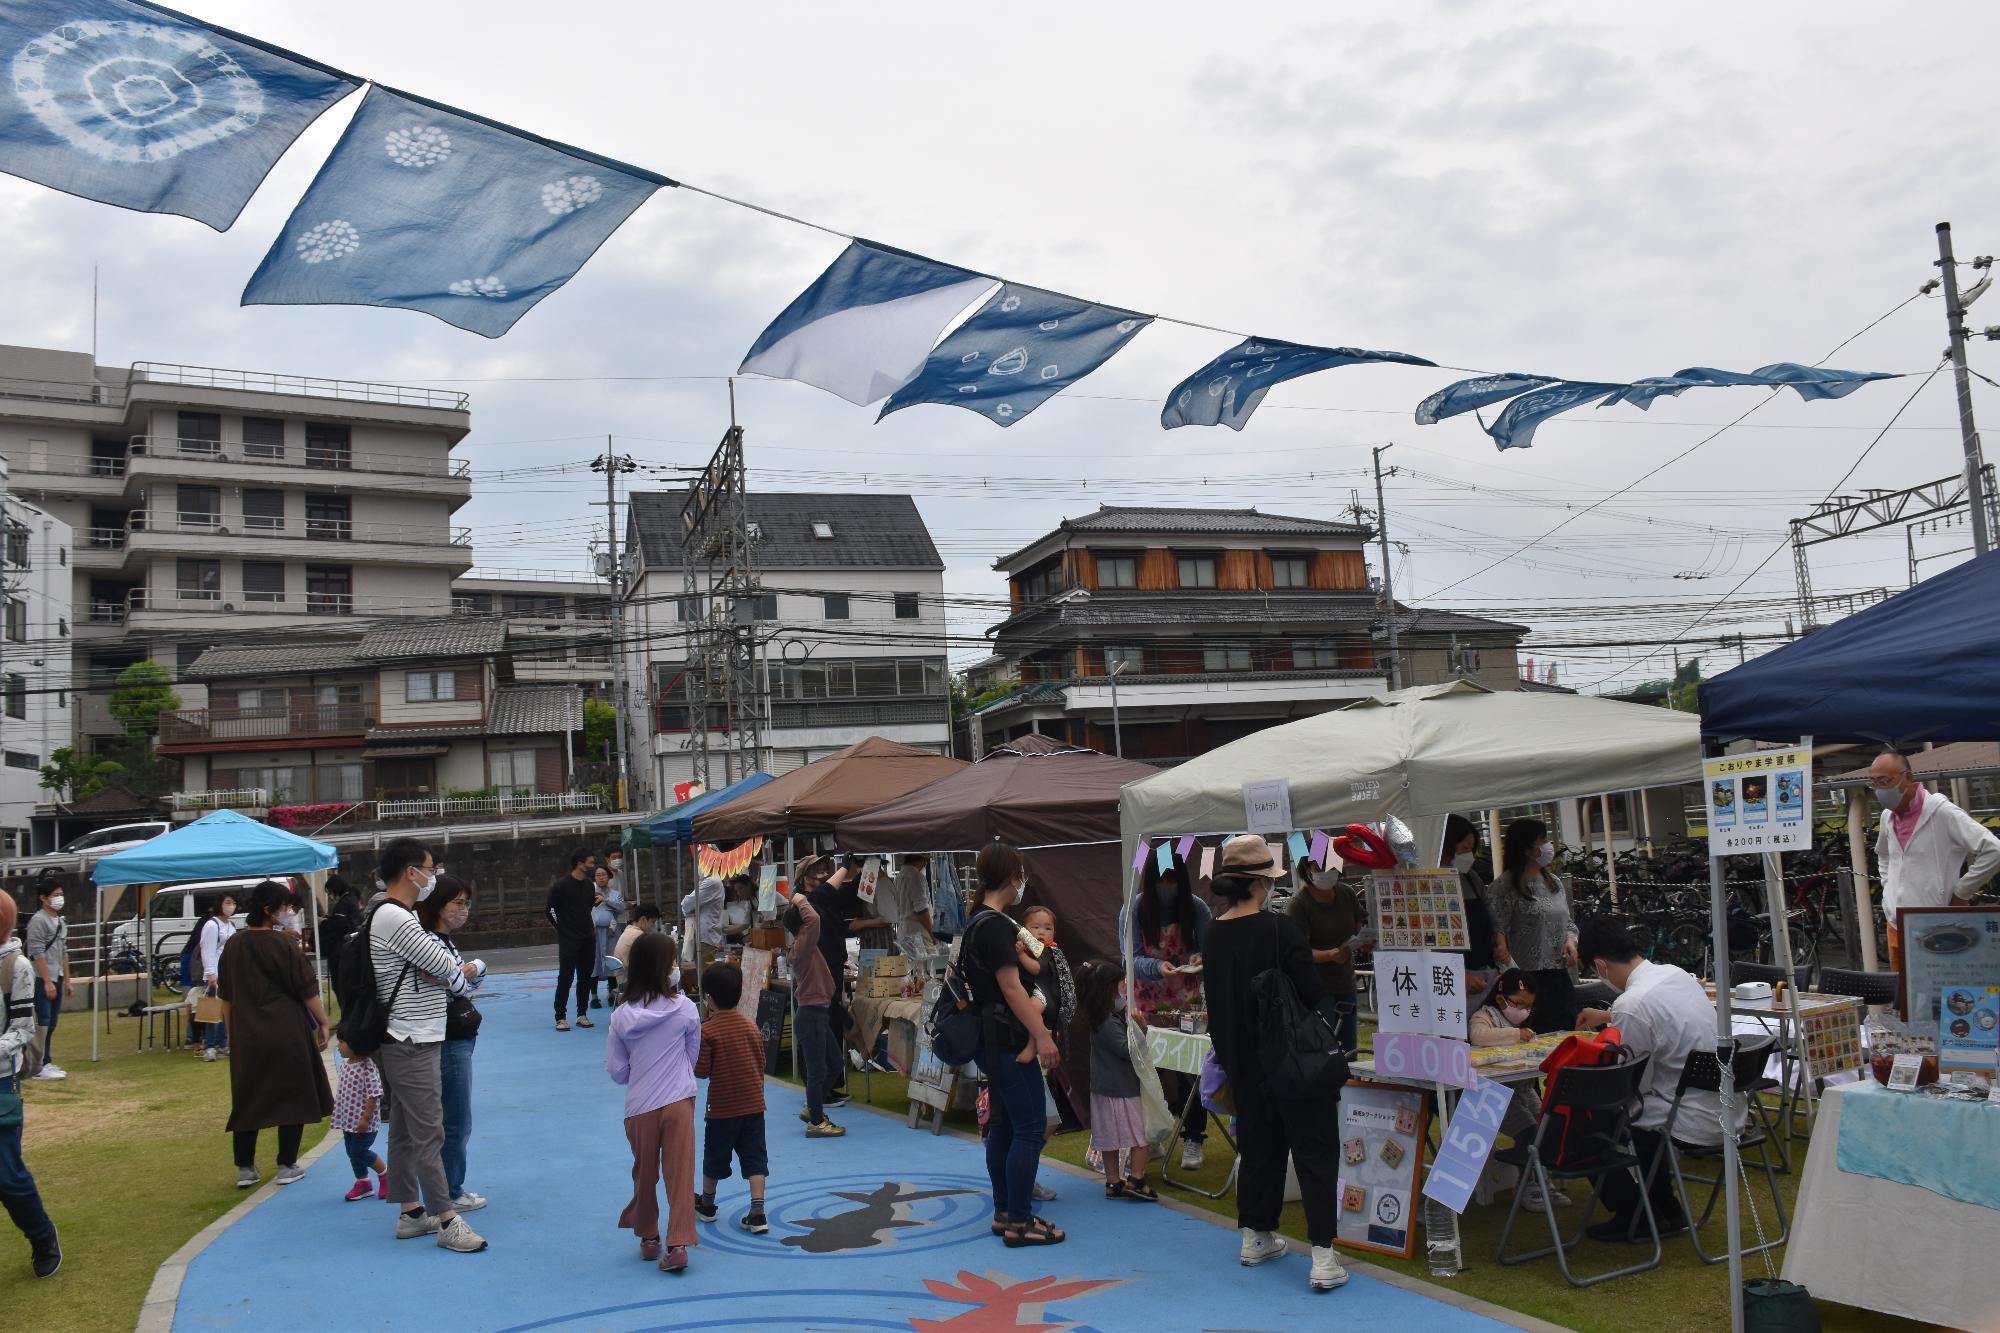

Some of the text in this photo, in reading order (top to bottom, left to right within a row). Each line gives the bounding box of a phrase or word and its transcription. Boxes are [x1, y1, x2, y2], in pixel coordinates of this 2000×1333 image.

[1719, 754, 1796, 772] こおりやま学習帳
[1391, 965, 1456, 997] 体験
[1388, 1002, 1464, 1024] できます
